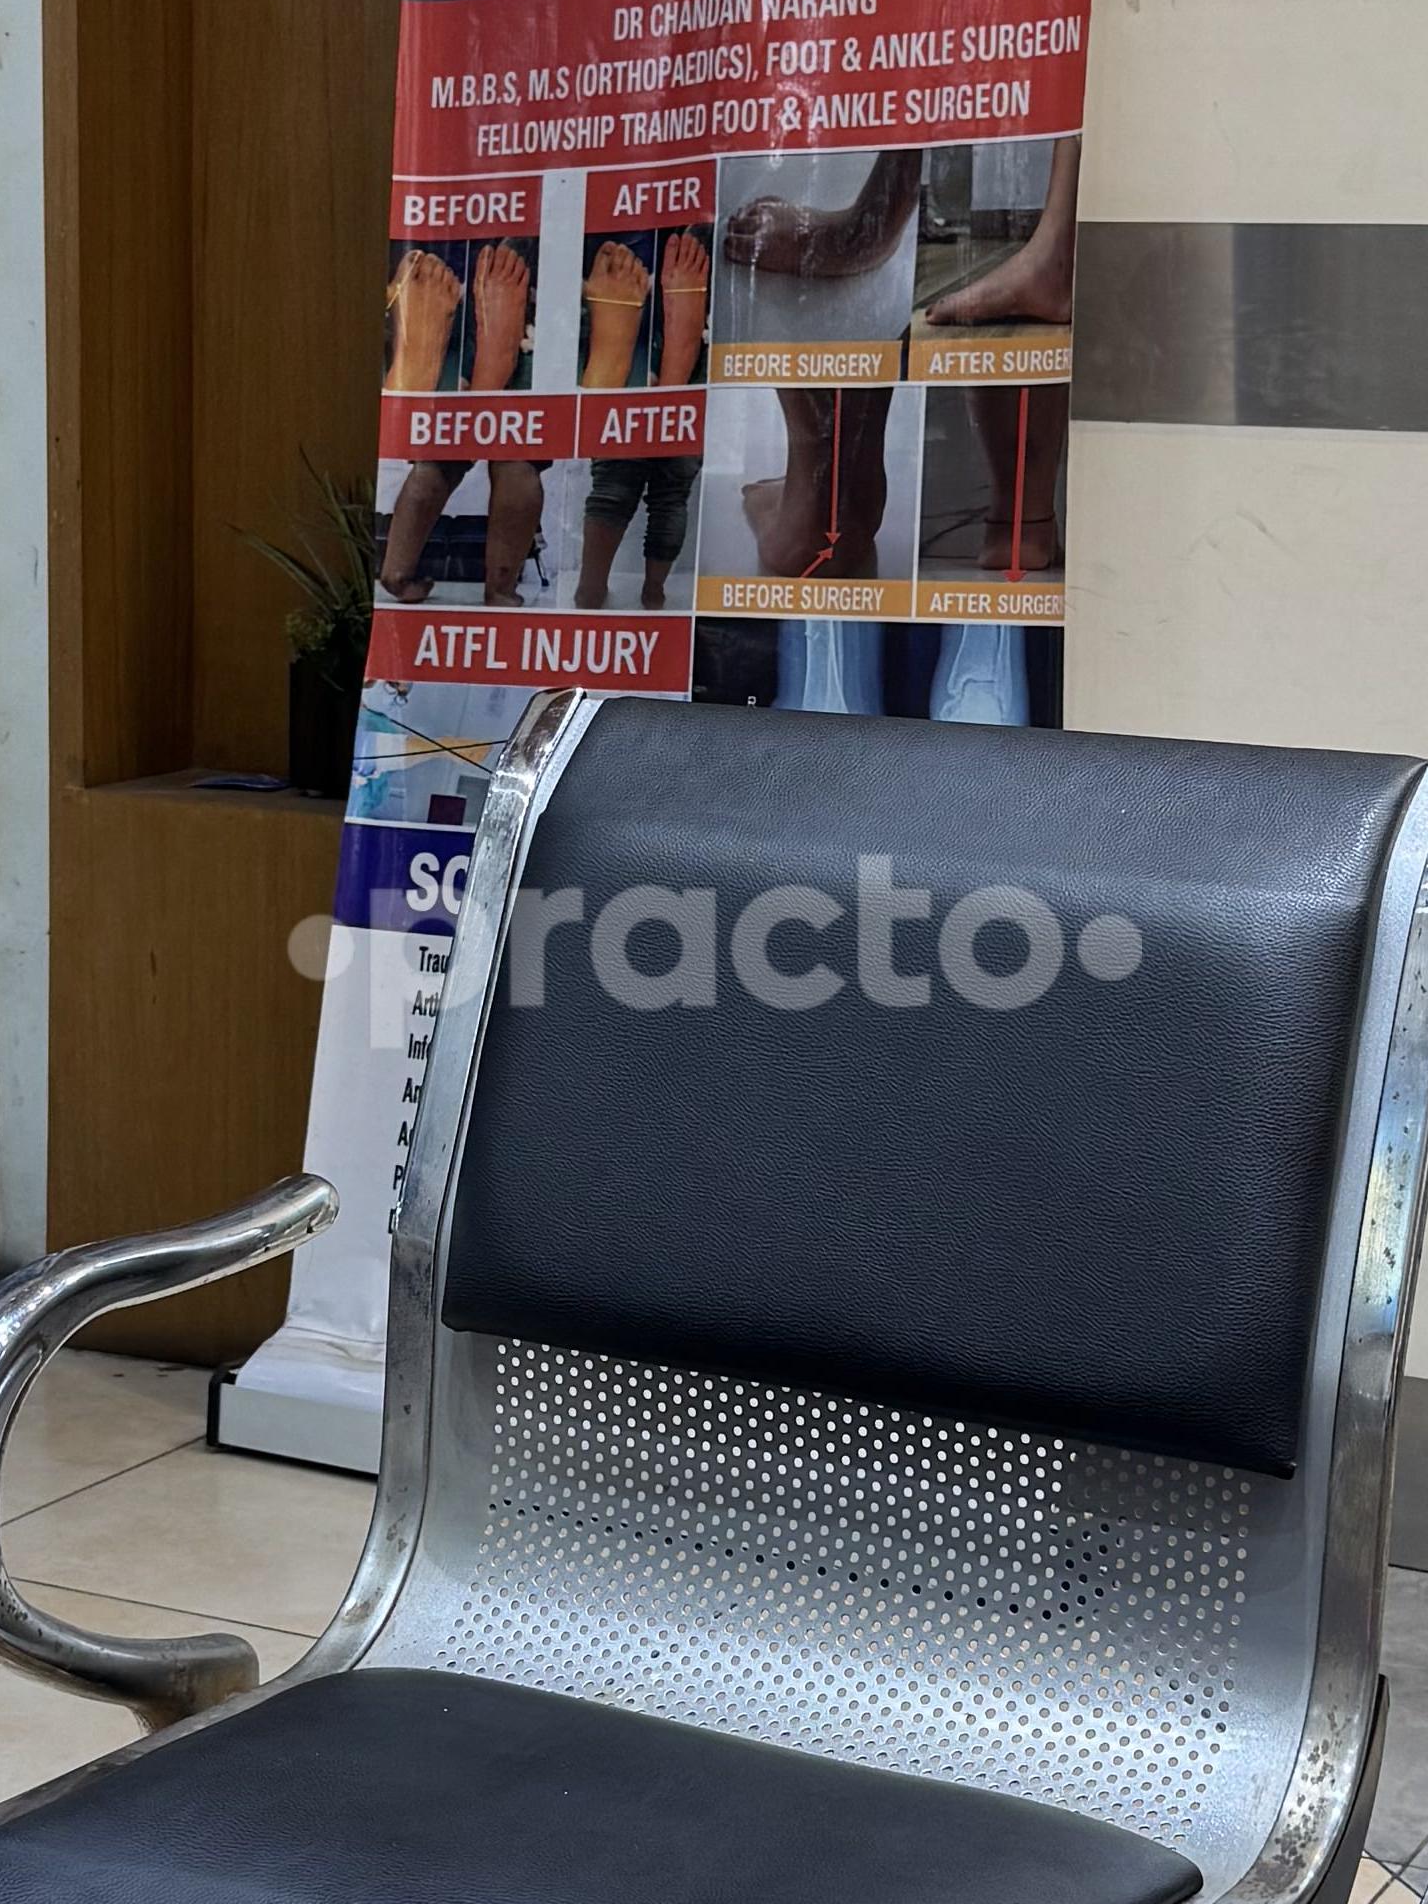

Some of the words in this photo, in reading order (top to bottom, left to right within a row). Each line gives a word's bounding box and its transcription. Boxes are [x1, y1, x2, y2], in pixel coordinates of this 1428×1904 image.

[614, 7, 643, 41] DR
[431, 72, 522, 109] M.B.B.S,
[528, 66, 570, 102] M.S
[576, 43, 758, 103] (ORTHOPAEDICS),
[766, 39, 836, 76] FOOT
[841, 37, 862, 72] &
[869, 29, 955, 71] ANKLE
[961, 15, 1081, 63] SURGEON
[477, 115, 615, 157] FELLOWSHIP
[621, 104, 706, 146] TRAINED
[712, 97, 775, 136] FOOT
[780, 96, 801, 130] &
[808, 90, 897, 129] ANKLE
[904, 80, 1030, 125] SURGEON
[403, 192, 526, 226] BEFORE
[612, 177, 700, 217] AFTER
[724, 353, 791, 376] BEFORE
[797, 352, 883, 376] SURGERY
[929, 351, 996, 374] AFTER
[410, 410, 544, 445] BEFORE
[600, 405, 697, 445] AFTER
[723, 583, 794, 608] BEFORE
[800, 584, 884, 611] SURGERY
[929, 592, 991, 614] AFTER
[414, 625, 508, 669] ATFL
[521, 628, 659, 674] INJURY
